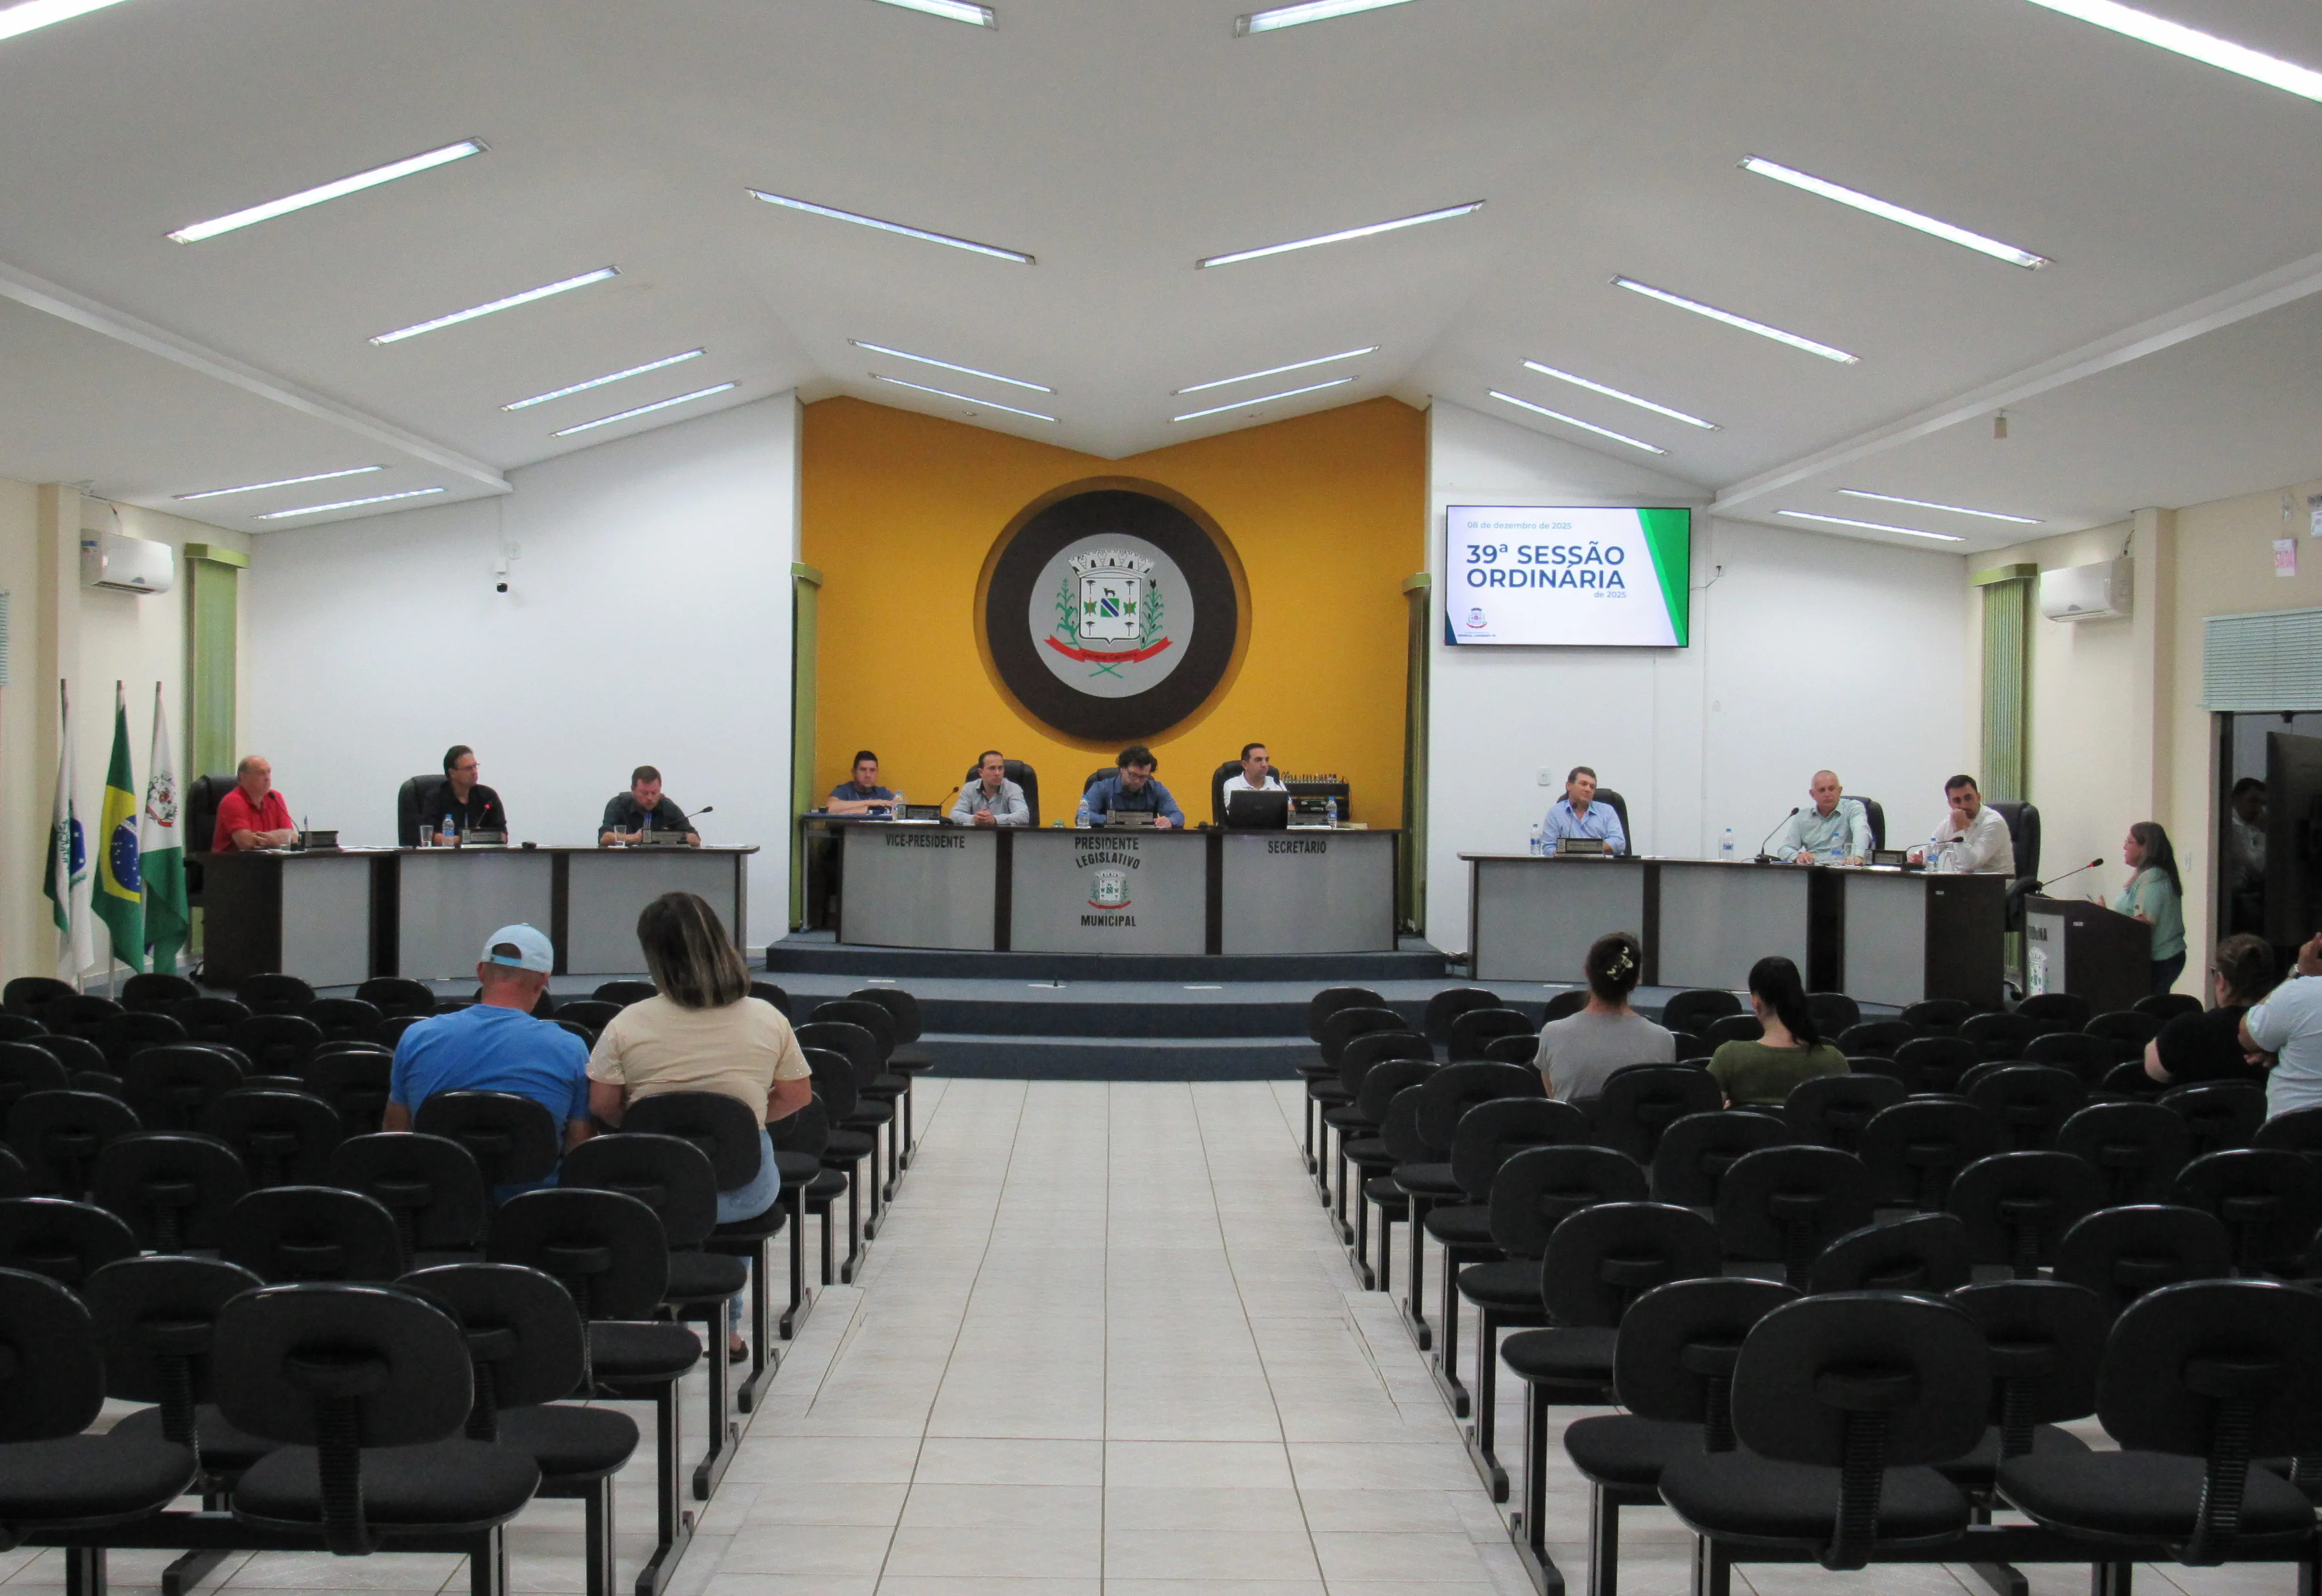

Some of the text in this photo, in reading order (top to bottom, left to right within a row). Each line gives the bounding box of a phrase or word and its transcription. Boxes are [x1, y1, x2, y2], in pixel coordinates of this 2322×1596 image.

[1466, 541, 1625, 565] 39ª SESSÃO
[1467, 563, 1625, 588] ORDINÁRIA
[885, 834, 965, 848] VICE-PRESIDENTE
[1075, 837, 1139, 850] PRESIDENTE
[1075, 852, 1140, 869] LEGISLATIVO
[1081, 915, 1136, 926] MUNICIPAL
